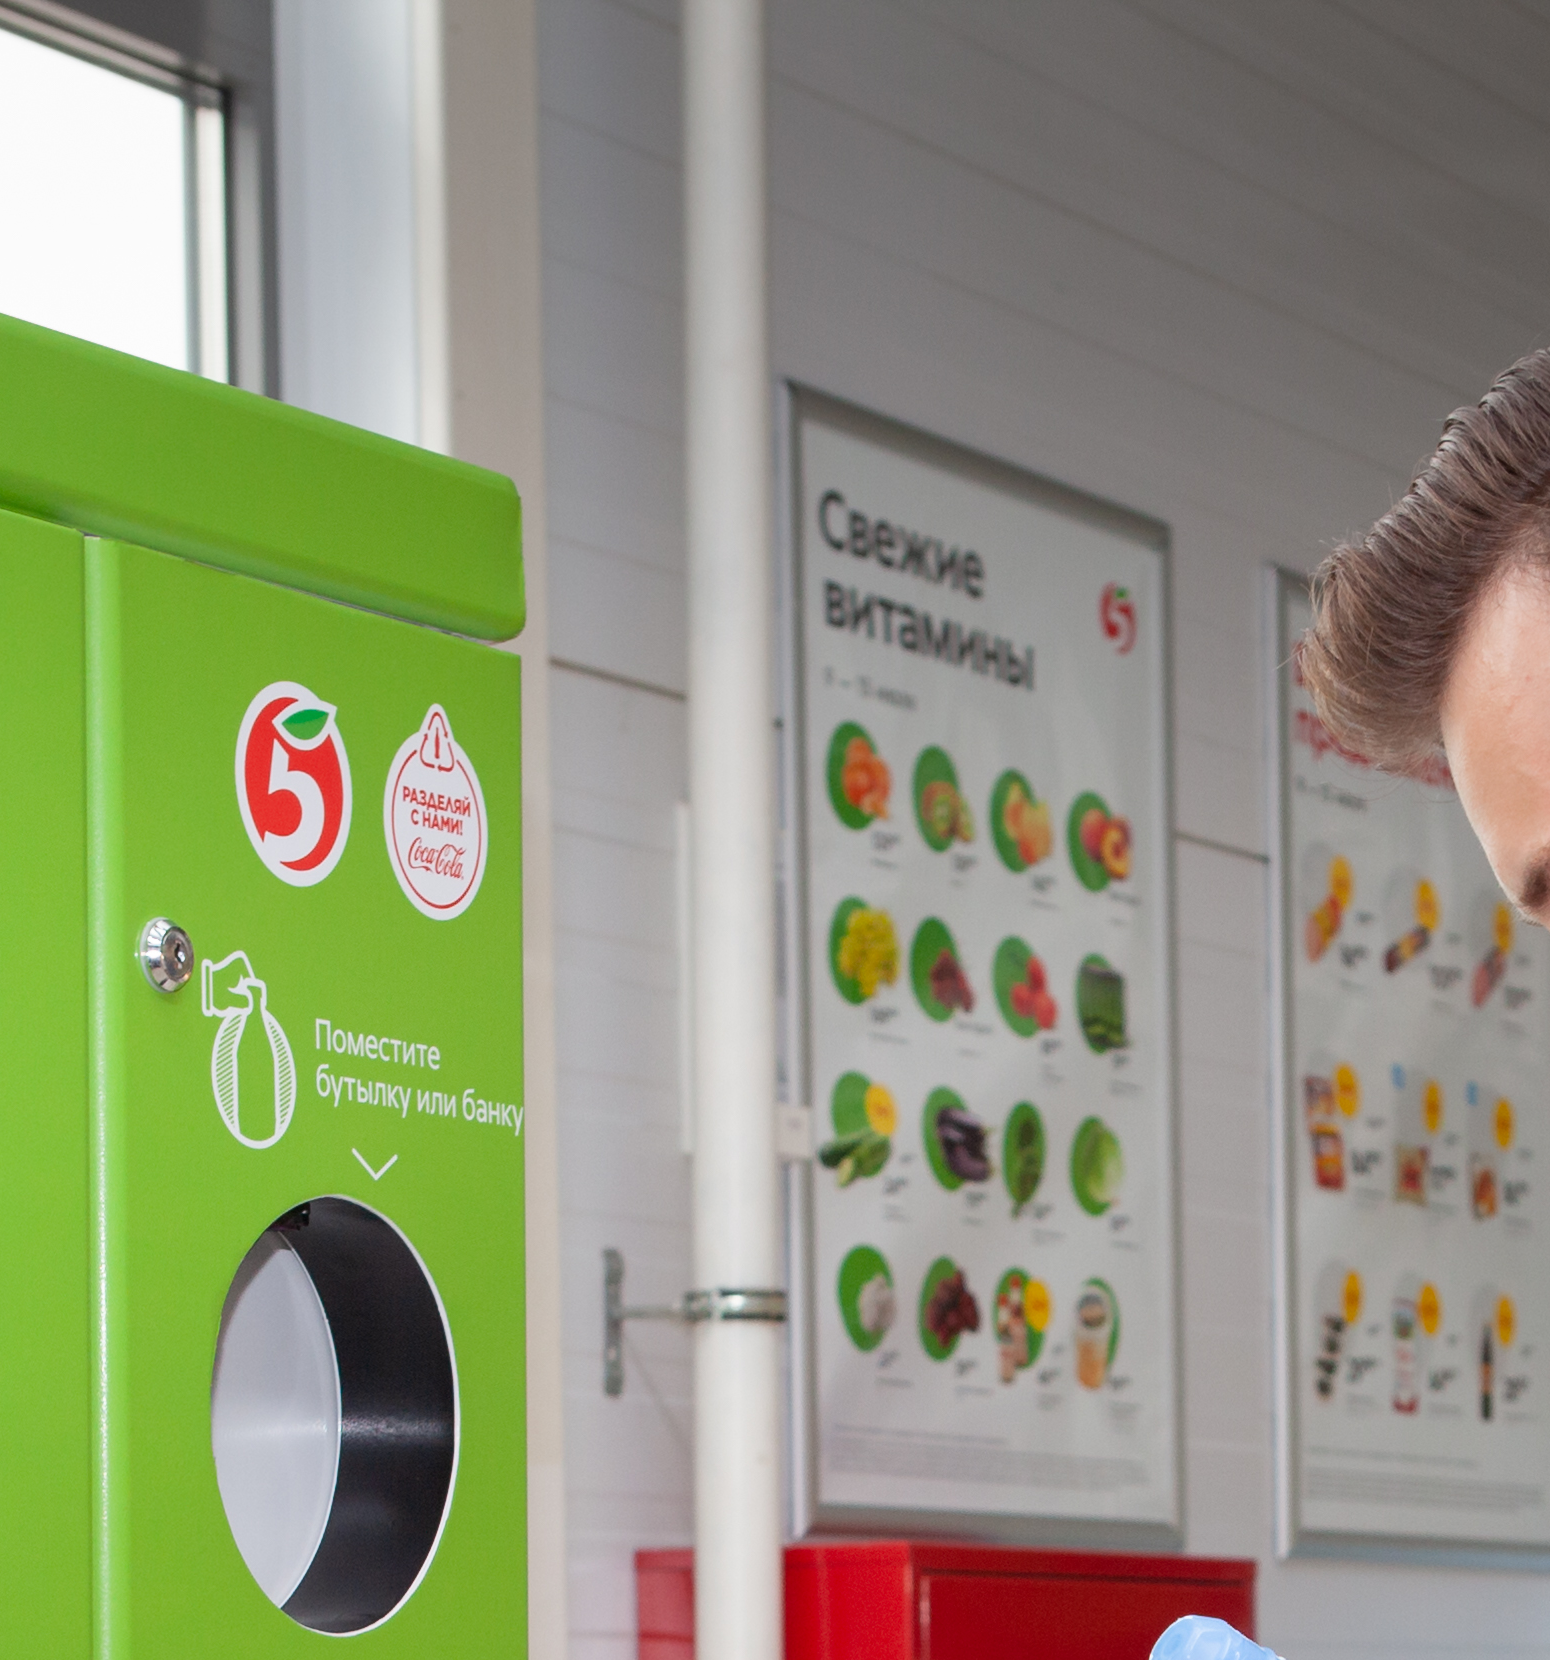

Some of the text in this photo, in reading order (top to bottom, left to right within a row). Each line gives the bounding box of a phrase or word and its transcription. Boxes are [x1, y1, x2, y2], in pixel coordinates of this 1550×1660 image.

[819, 490, 984, 598] Свежие
[822, 579, 1035, 691] витамины
[403, 786, 471, 817] РАЗДЕЛЯЙ
[411, 809, 463, 836] С НАМИ!
[408, 837, 467, 879] Coca-Cola
[315, 1018, 441, 1070] Поместите
[316, 1064, 524, 1136] бутылку или банку
